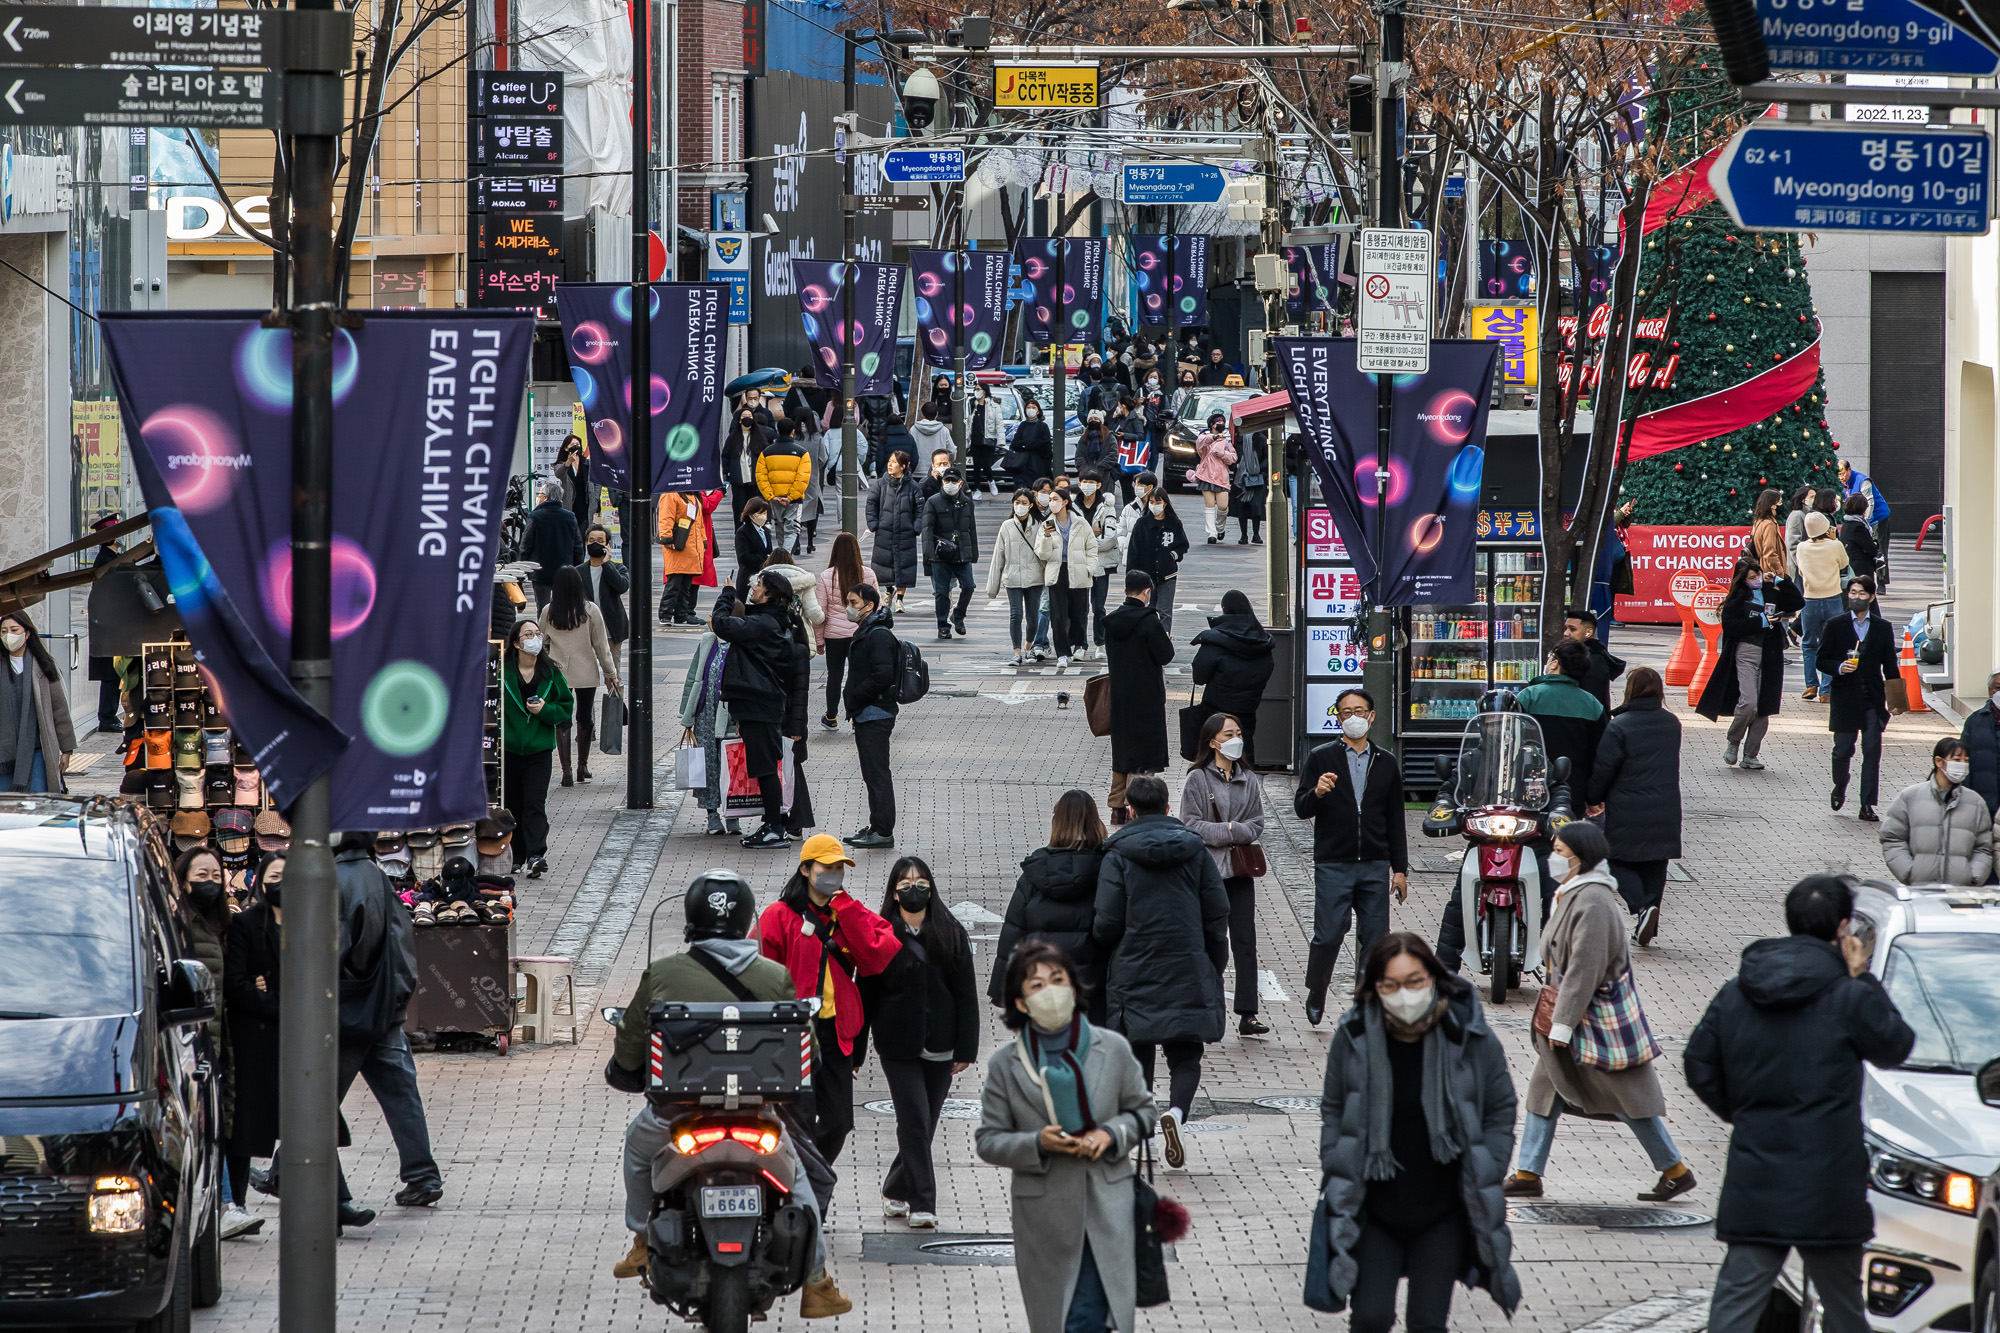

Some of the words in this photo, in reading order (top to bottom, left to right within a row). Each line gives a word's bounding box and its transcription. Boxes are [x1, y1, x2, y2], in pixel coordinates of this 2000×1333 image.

[133, 12, 194, 36] 이회영
[200, 13, 262, 37] 기념관
[1763, 17, 1900, 43] Myeongdong
[1905, 21, 1954, 45] 9-gil
[1018, 71, 1046, 82] 다목적
[492, 82, 527, 92] Coffee
[1018, 83, 1094, 104] CCTV작동중
[118, 100, 148, 110] Solaria
[150, 101, 173, 111] Hotel
[175, 101, 199, 111] Seoul
[492, 95, 500, 104] &
[503, 95, 527, 104] Beer
[547, 104, 558, 112] 9F
[494, 126, 552, 147] 방탈출
[495, 152, 529, 160] Alcatraz
[547, 152, 558, 160] 8F
[929, 153, 962, 163] 명동8길
[1745, 149, 1765, 164] 62
[1785, 150, 1791, 164] 1
[1862, 139, 1983, 175] 명동10길
[1129, 168, 1165, 180] 명동7길
[1129, 183, 1176, 192] Myeongdong
[1178, 183, 1195, 191] 7-gil
[1773, 176, 1914, 203] Myeongdong
[1921, 181, 1981, 205] 10-gil
[548, 200, 558, 208] 7F
[510, 219, 535, 233] WE
[494, 236, 551, 249] 시계거래소
[547, 248, 559, 256] 6F
[488, 269, 560, 292] 약손명가
[1290, 346, 1311, 401] LIGHT
[1312, 347, 1337, 461] EVERYTHING
[1417, 412, 1462, 424] Myeongdong
[1653, 535, 1725, 549] MYEONG
[1729, 535, 1751, 548] DO
[1655, 556, 1734, 570] CHANGES
[1312, 573, 1361, 600] 상품
[718, 1198, 756, 1212] 6646
